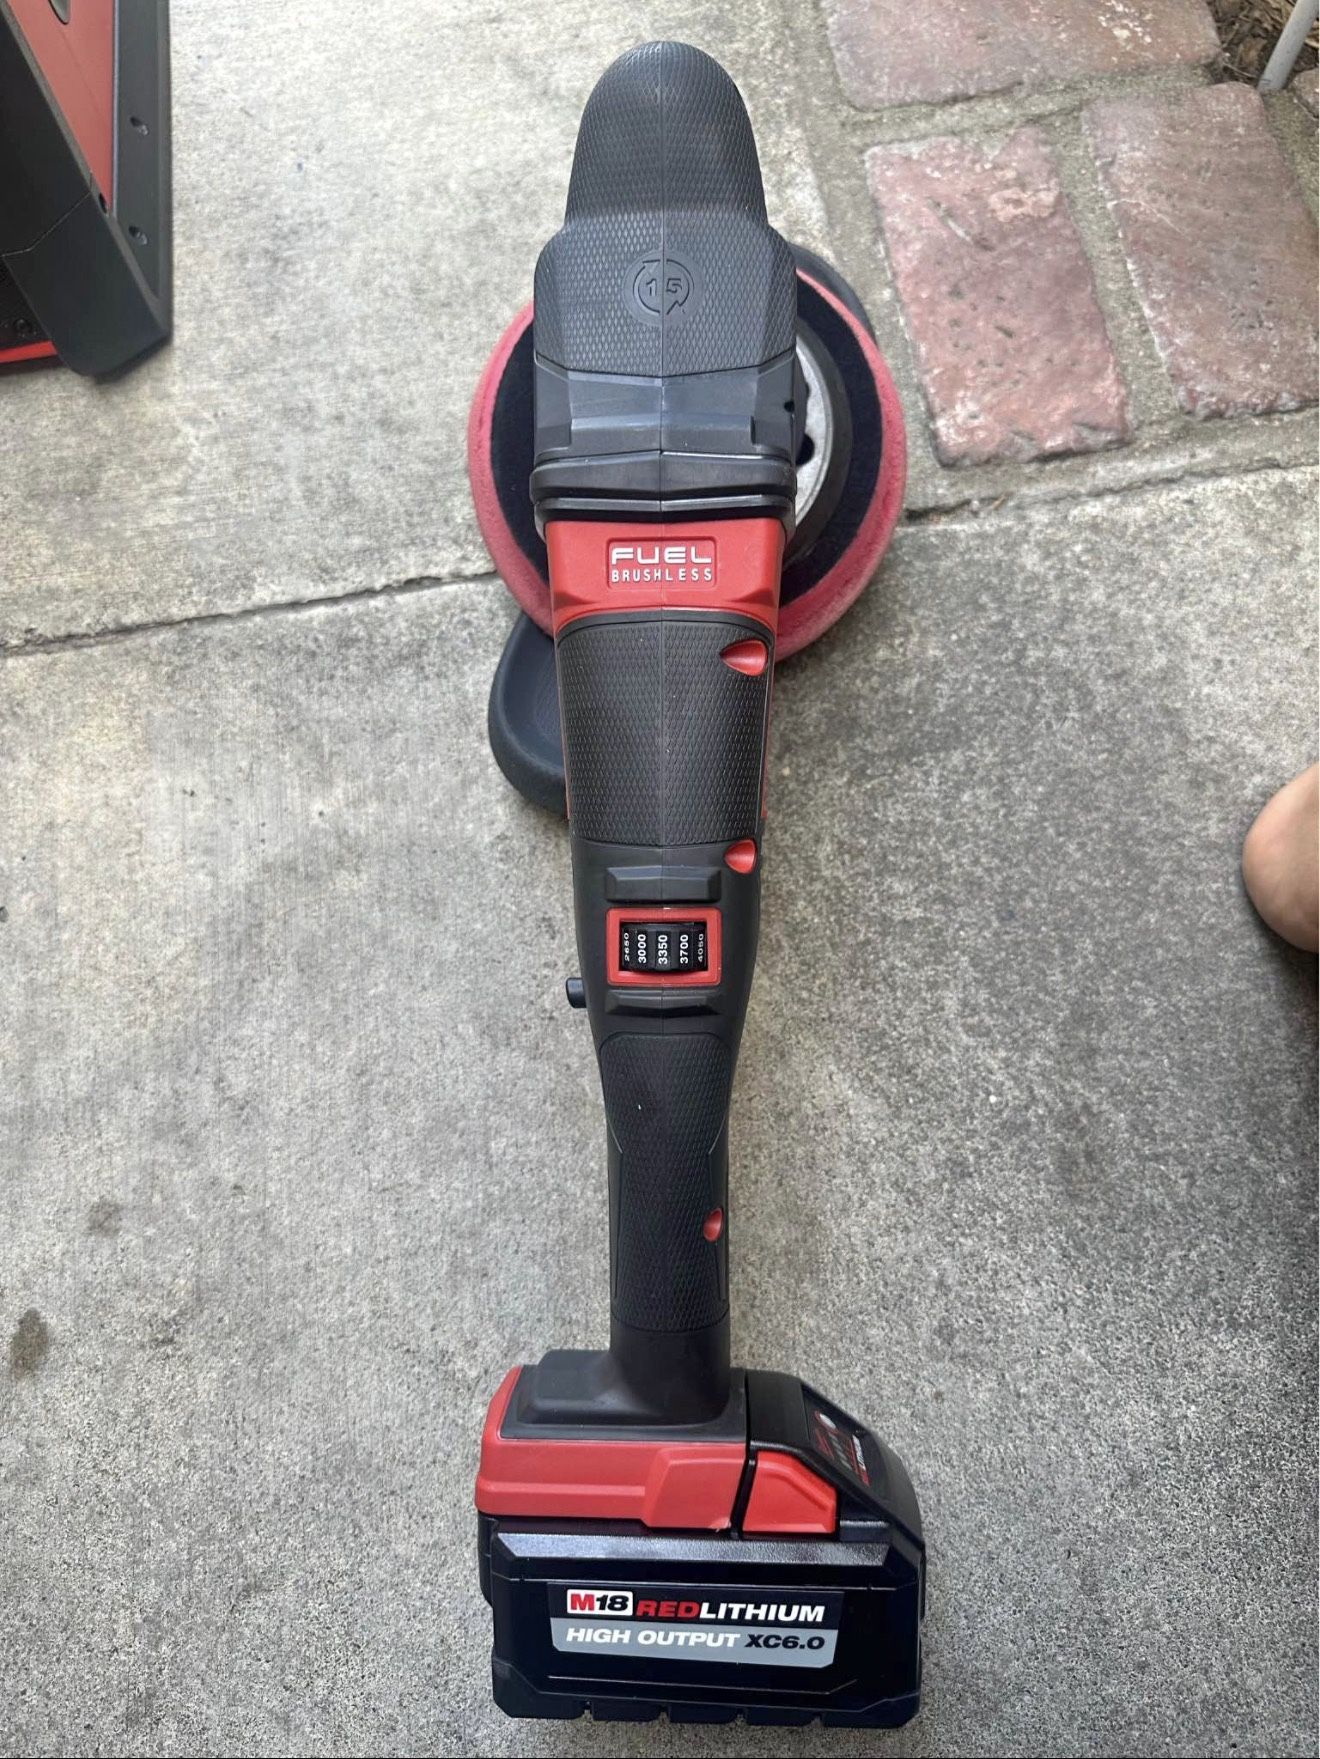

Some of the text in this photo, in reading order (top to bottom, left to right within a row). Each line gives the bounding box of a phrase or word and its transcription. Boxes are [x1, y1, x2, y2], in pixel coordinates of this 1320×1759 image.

[645, 278, 683, 296] 15
[611, 546, 712, 565] FUEL
[611, 568, 712, 583] BRUSHLESS
[637, 933, 647, 964] 3000
[658, 934, 668, 965] 3350
[680, 934, 689, 964] 3700
[570, 1593, 825, 1622] M18 REDLITHIUM
[566, 1627, 825, 1650] HIGH OUTPUT XC6.0
